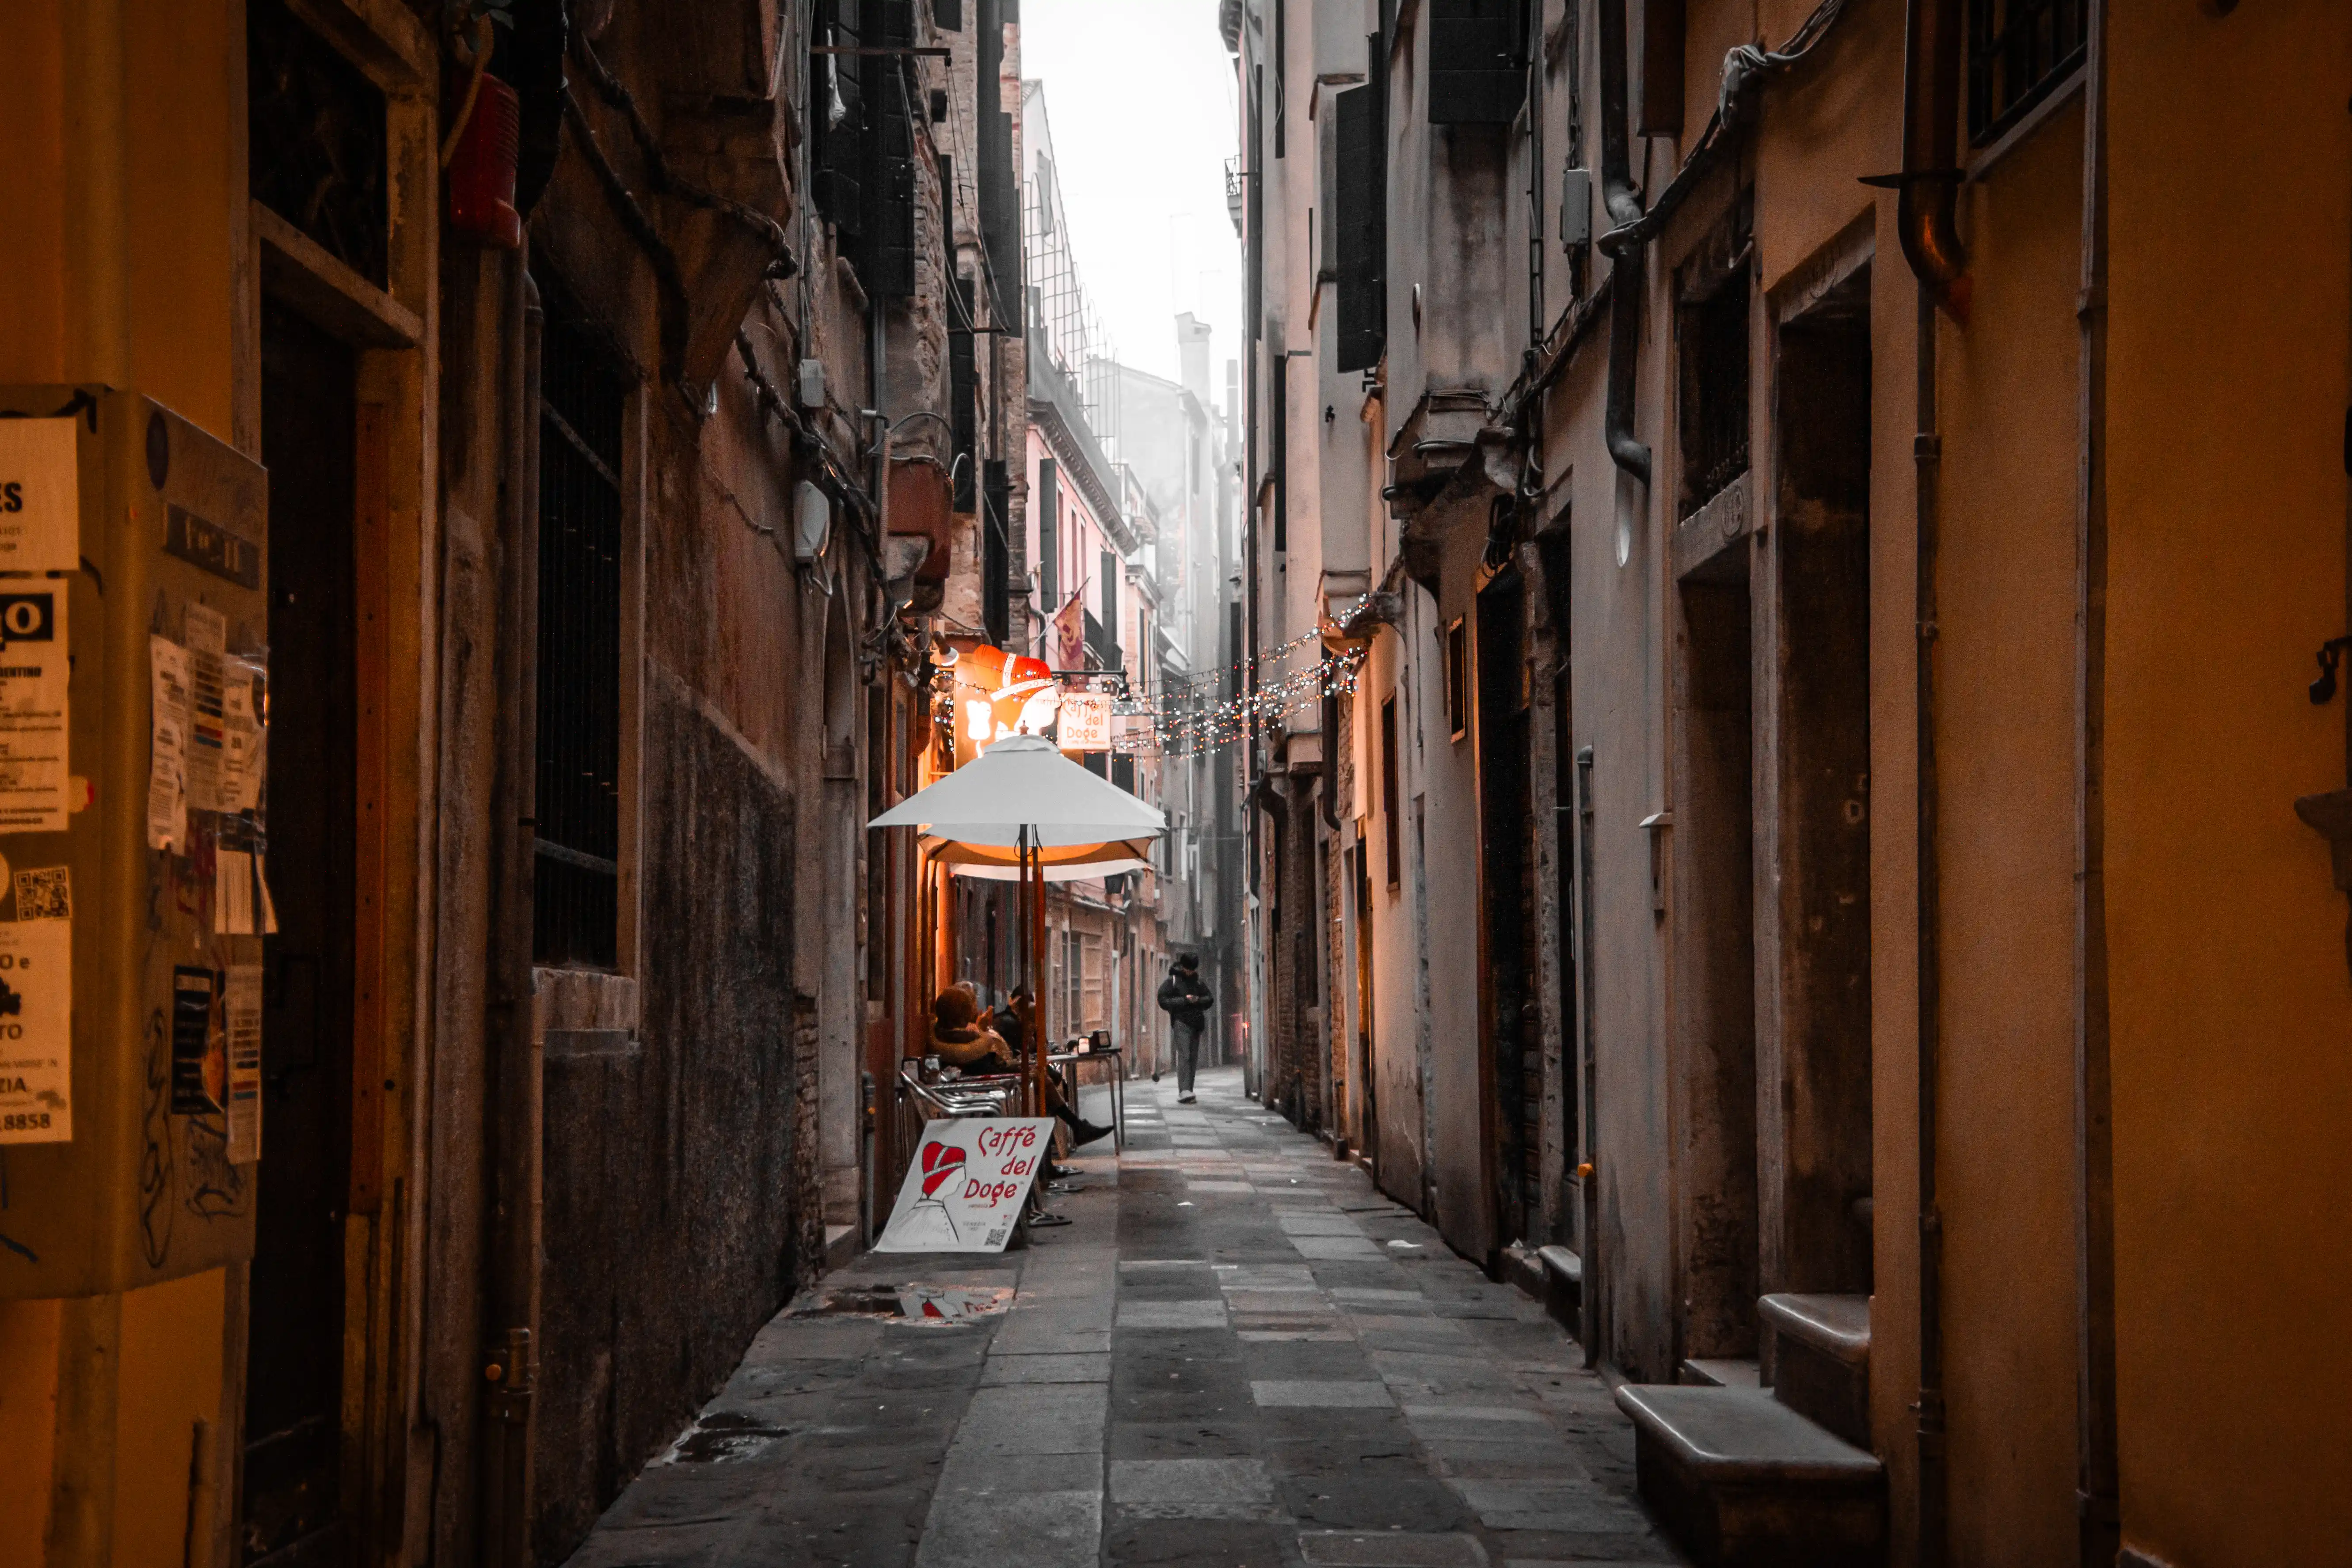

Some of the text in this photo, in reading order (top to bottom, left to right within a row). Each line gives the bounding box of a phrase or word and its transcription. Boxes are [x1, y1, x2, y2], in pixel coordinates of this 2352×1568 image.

[0, 481, 23, 513] S
[1085, 713, 1103, 726] del
[1066, 726, 1098, 744] Doge
[0, 1112, 50, 1130] 8858
[1001, 1155, 1036, 1176] del
[963, 1178, 1017, 1208] Doge
